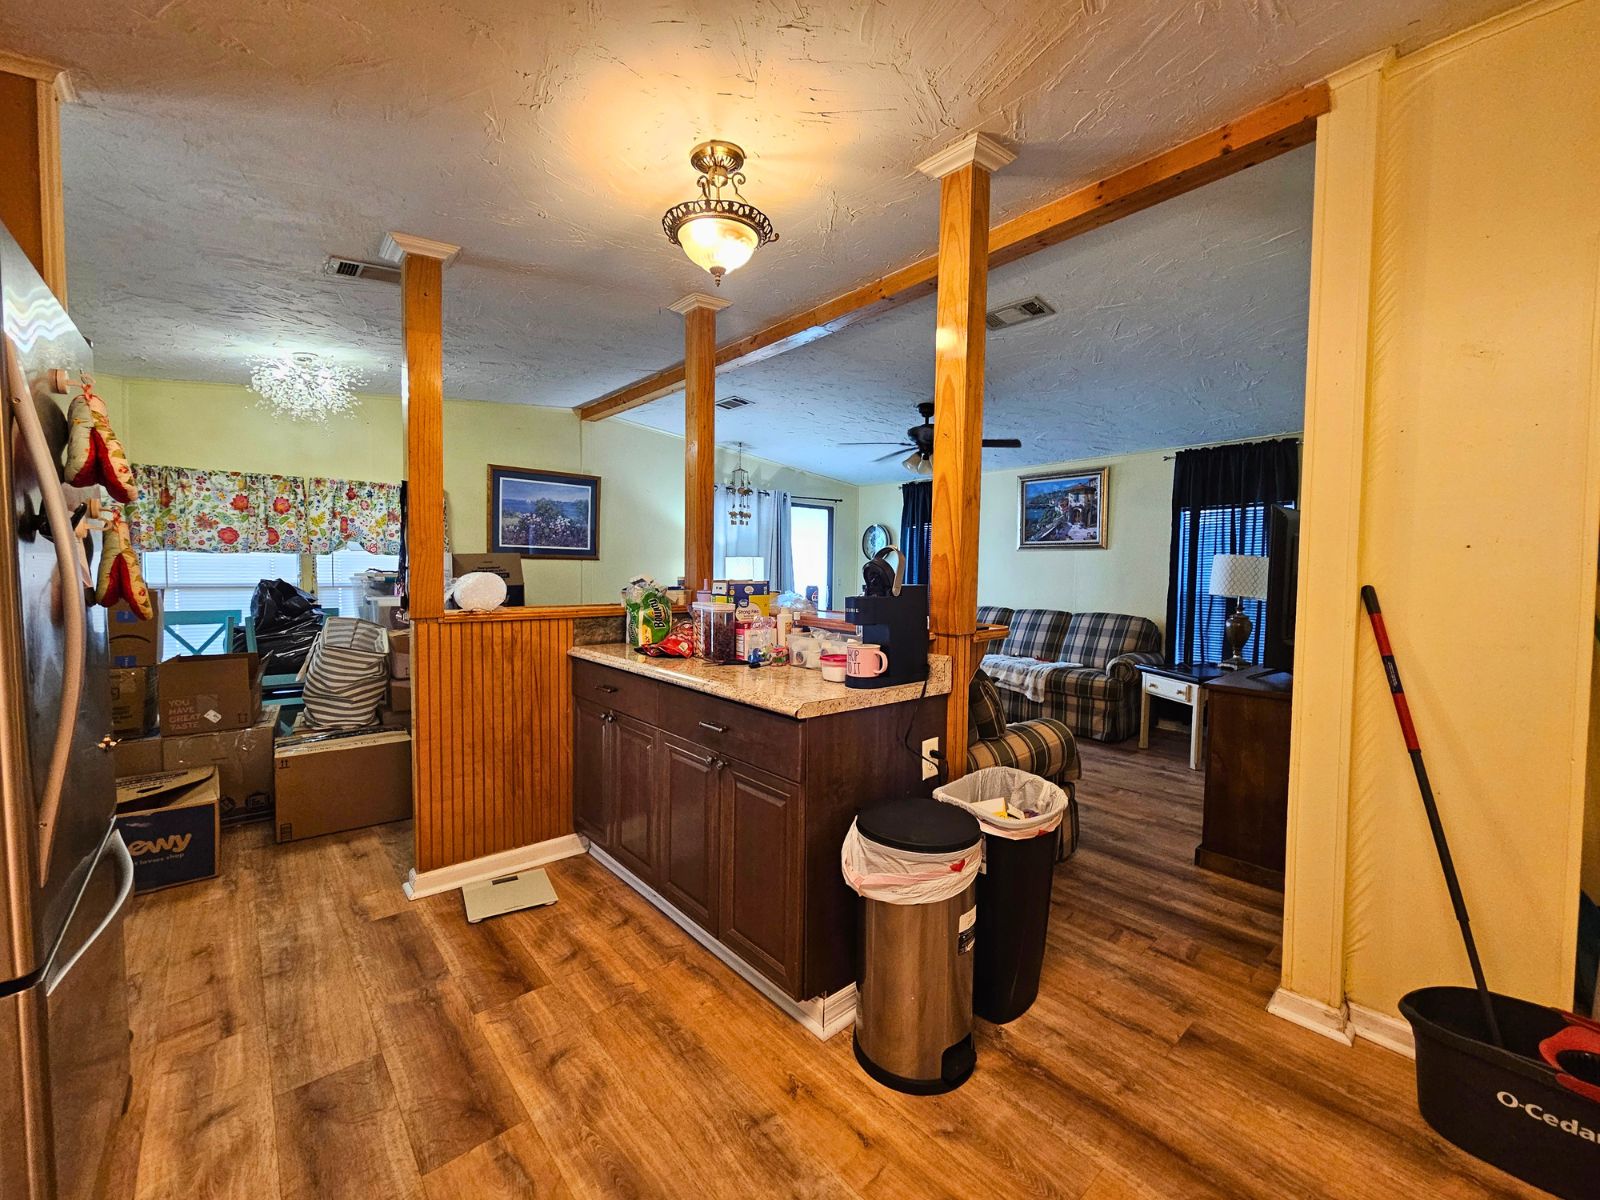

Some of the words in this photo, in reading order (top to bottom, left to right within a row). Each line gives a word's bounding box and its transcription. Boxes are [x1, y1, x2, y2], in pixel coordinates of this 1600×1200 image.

[648, 598, 666, 629] Bounty
[168, 699, 190, 707] YOU
[168, 706, 195, 715] HAVE
[168, 713, 201, 723] GREAT
[170, 721, 200, 731] TASTE
[128, 833, 192, 857] ewy
